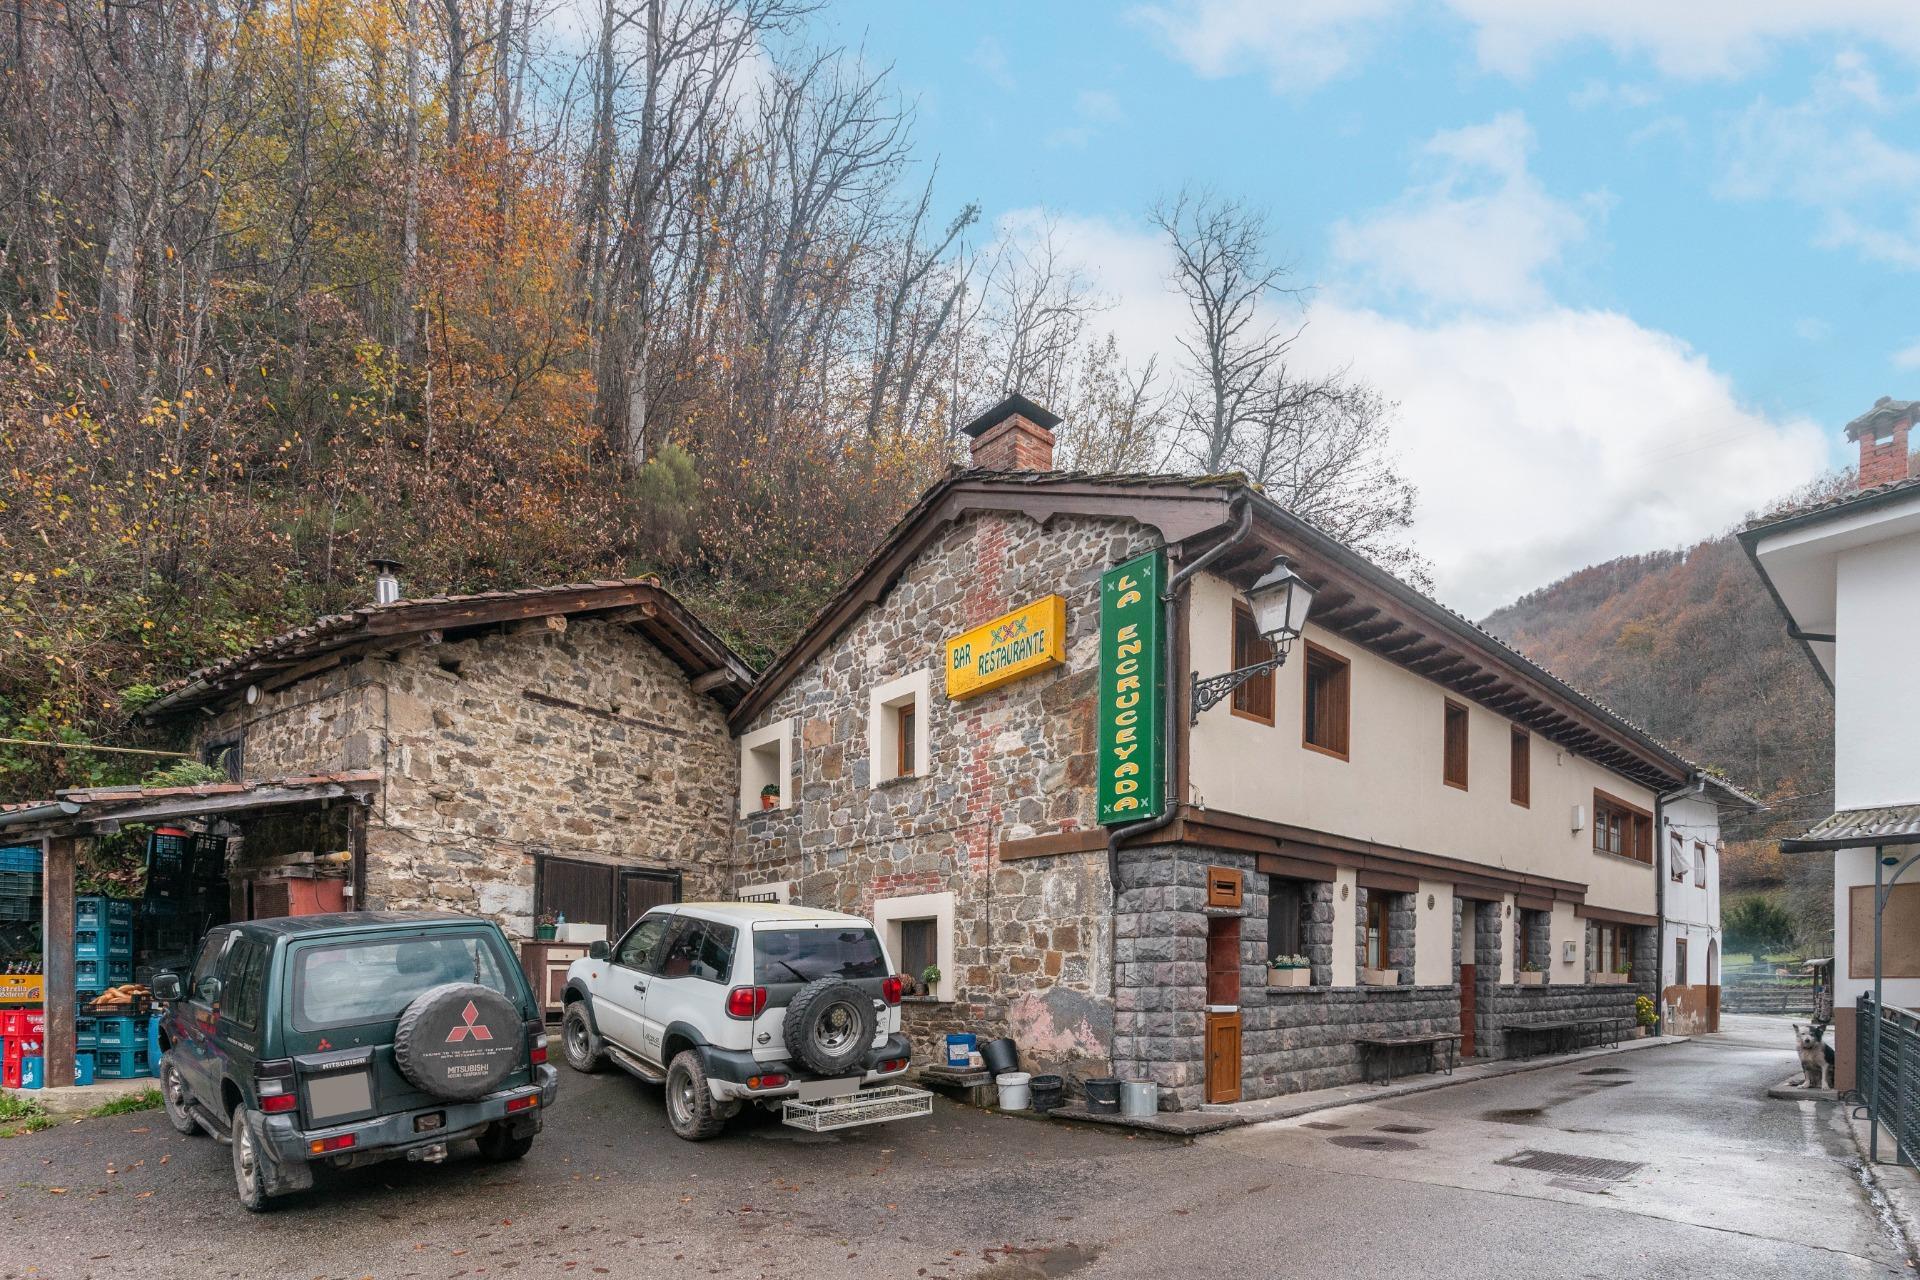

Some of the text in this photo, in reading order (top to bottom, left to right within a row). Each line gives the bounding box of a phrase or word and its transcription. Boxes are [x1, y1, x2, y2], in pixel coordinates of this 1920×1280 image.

[953, 629, 1045, 677] BAR RESTAURANTE
[1113, 575, 1142, 812] LA ENCRUCEYADA
[322, 1057, 367, 1069] MITSUBISHI
[447, 1063, 489, 1075] MITSUBISHI
